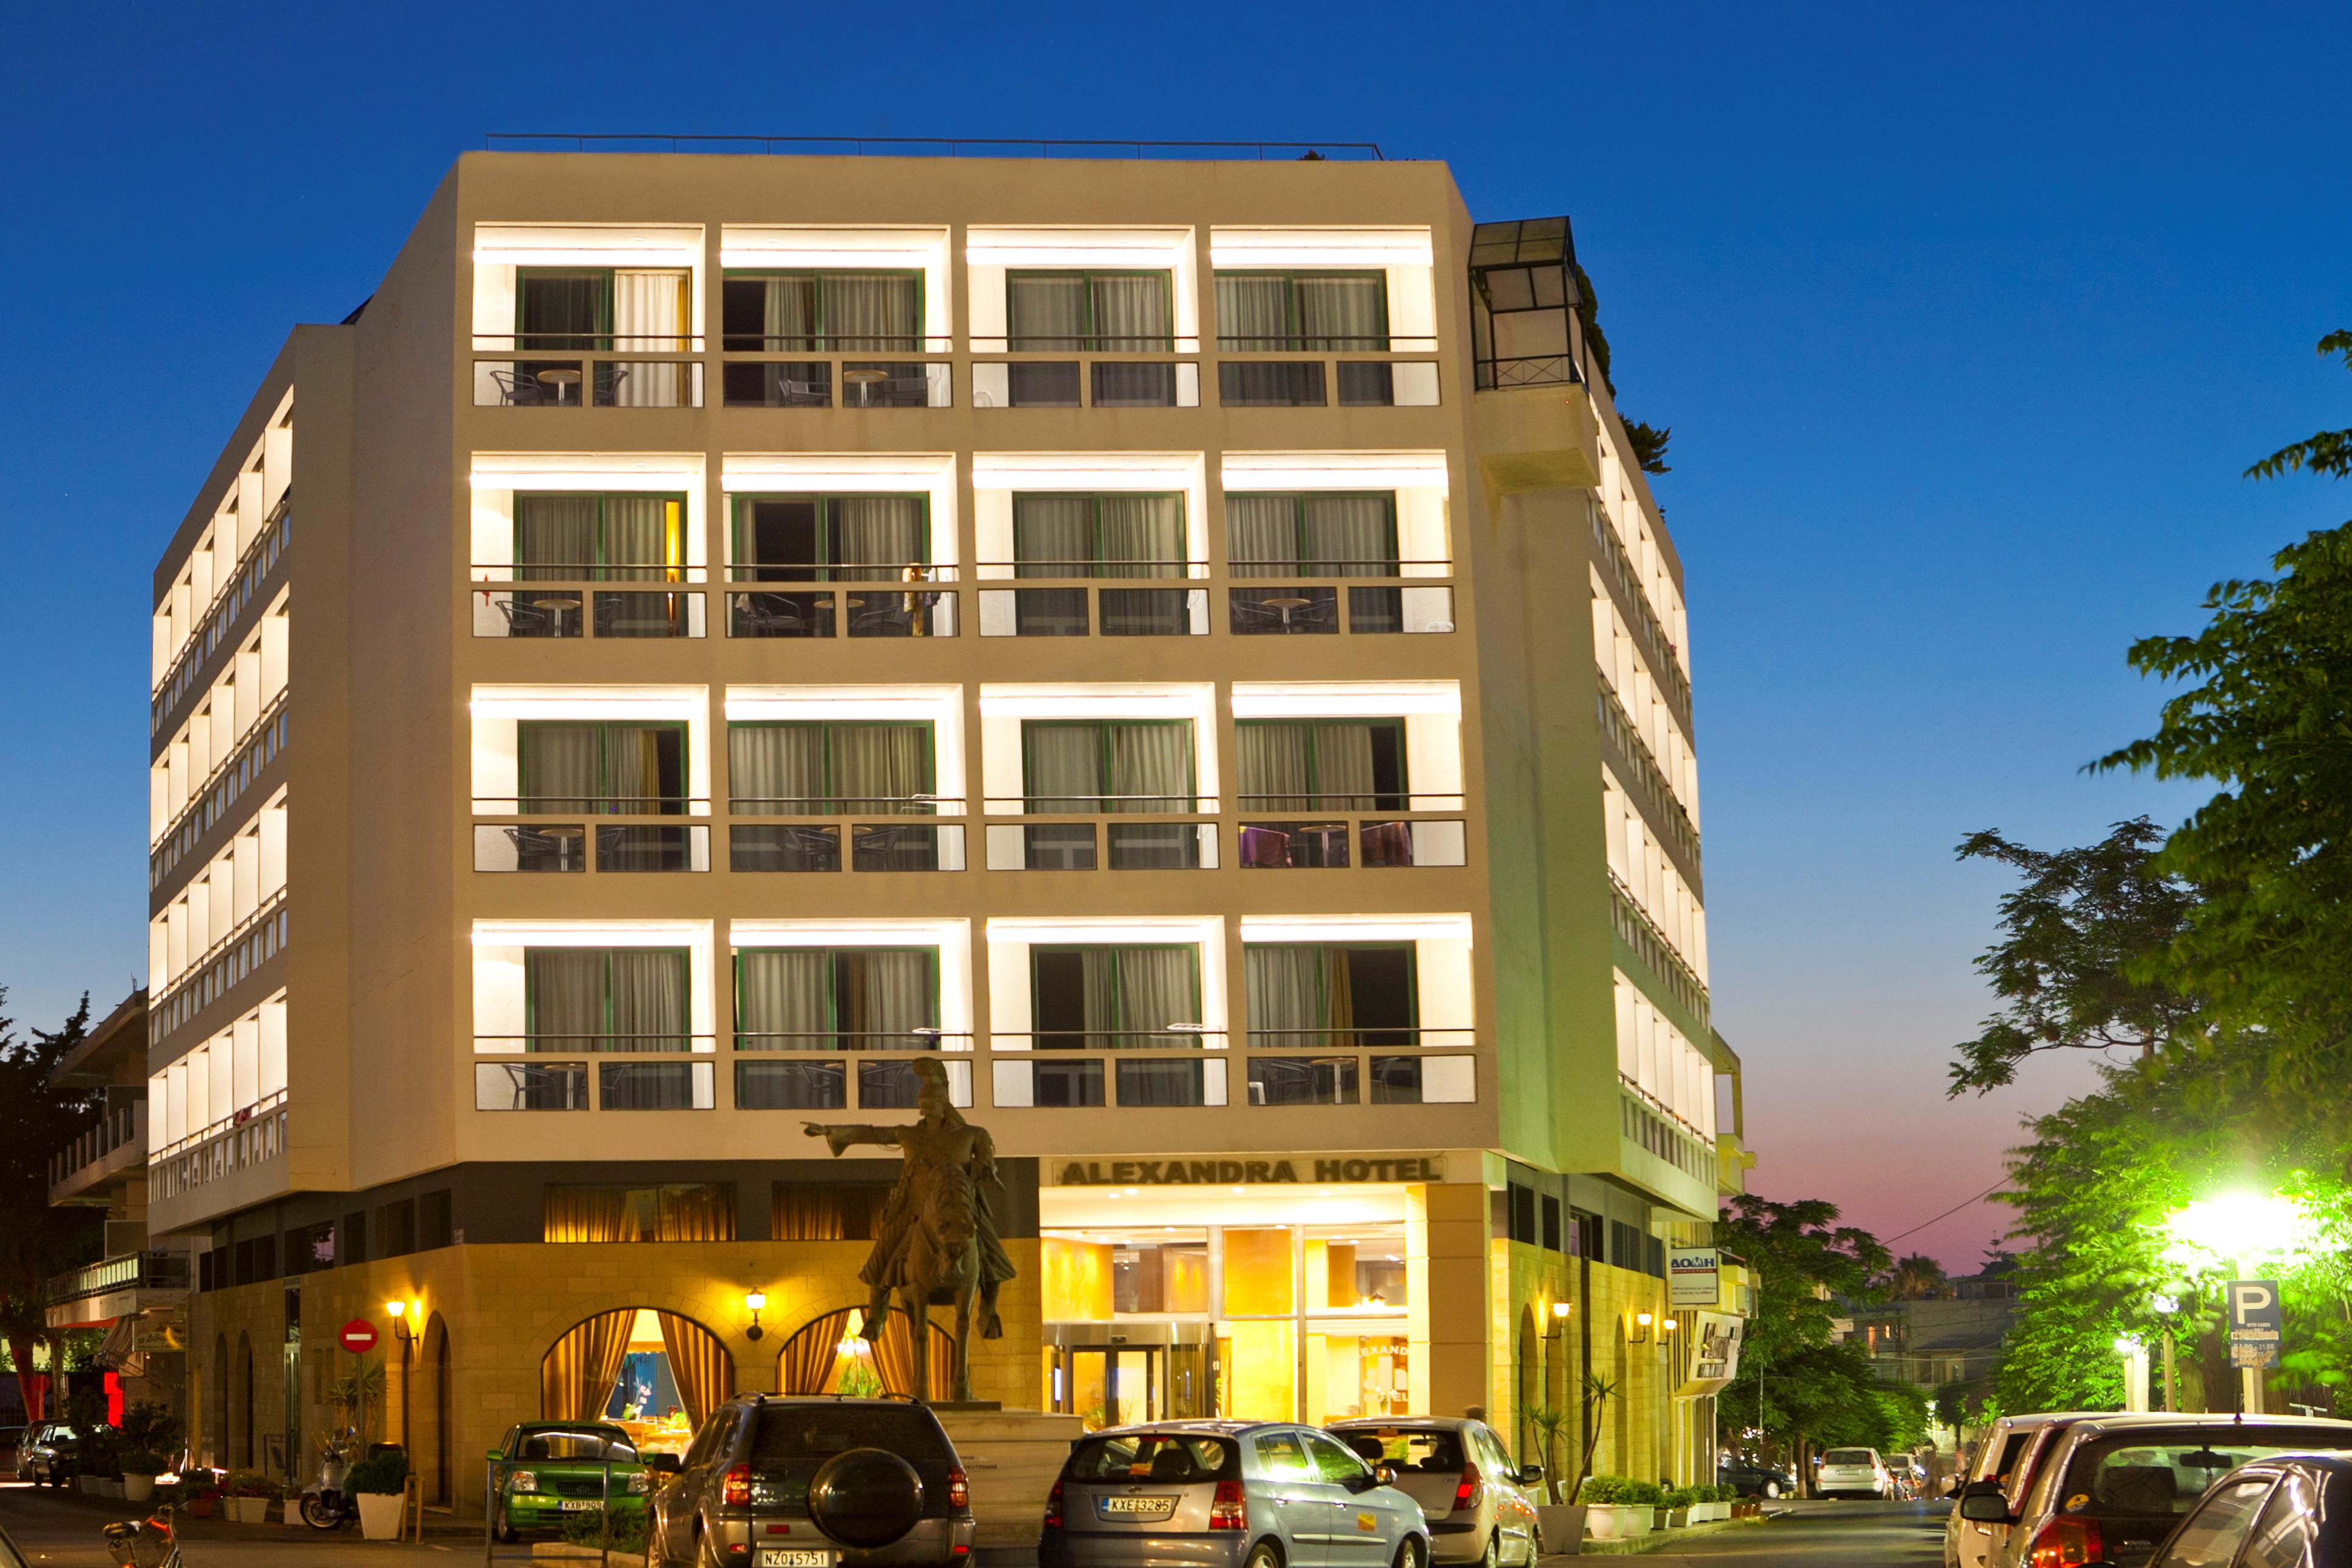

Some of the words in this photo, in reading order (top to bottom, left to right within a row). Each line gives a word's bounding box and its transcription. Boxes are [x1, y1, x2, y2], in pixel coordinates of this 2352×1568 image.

[1060, 1161, 1298, 1186] ALEXANDRA
[1315, 1157, 1442, 1182] HOTEL
[2235, 1286, 2272, 1325] P
[796, 1553, 824, 1565] 5751
